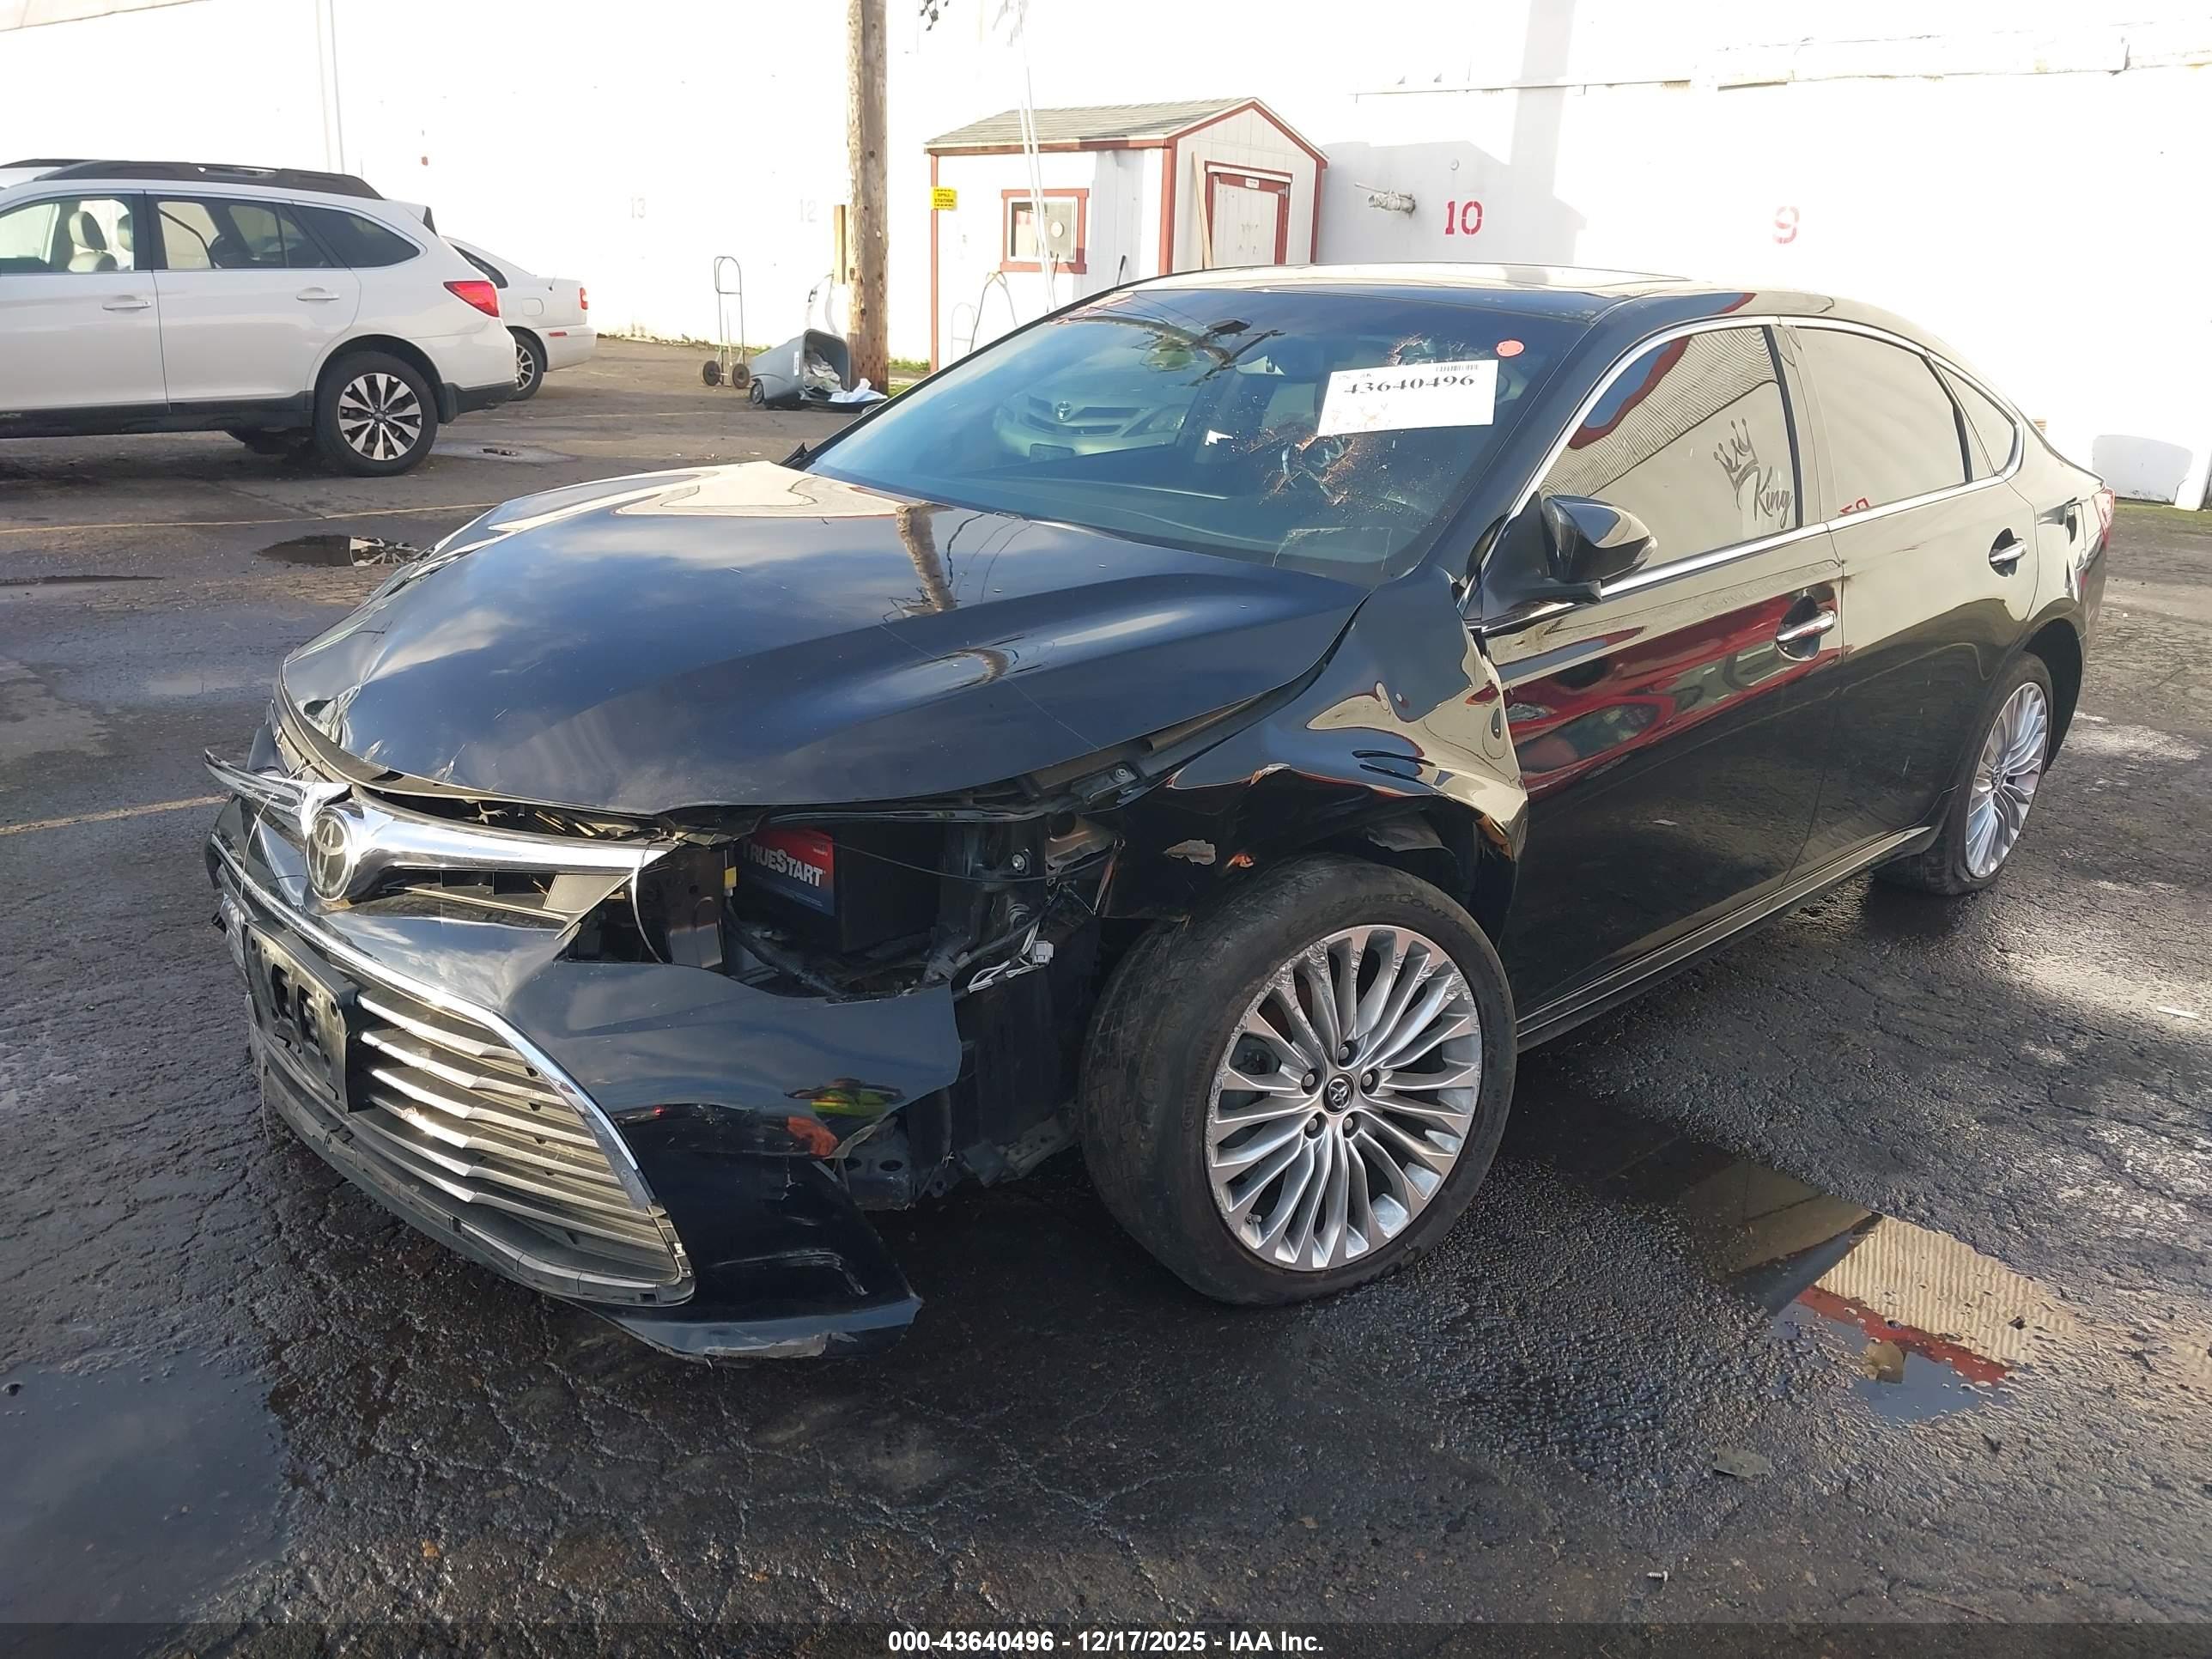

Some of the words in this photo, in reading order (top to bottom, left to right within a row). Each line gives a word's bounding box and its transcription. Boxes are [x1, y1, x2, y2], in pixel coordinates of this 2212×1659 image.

[1445, 201, 1483, 235] 10
[1773, 206, 1800, 244] 9
[1343, 374, 1476, 395] 43640496
[1737, 465, 1794, 529] King
[744, 841, 823, 887] TRUESTART
